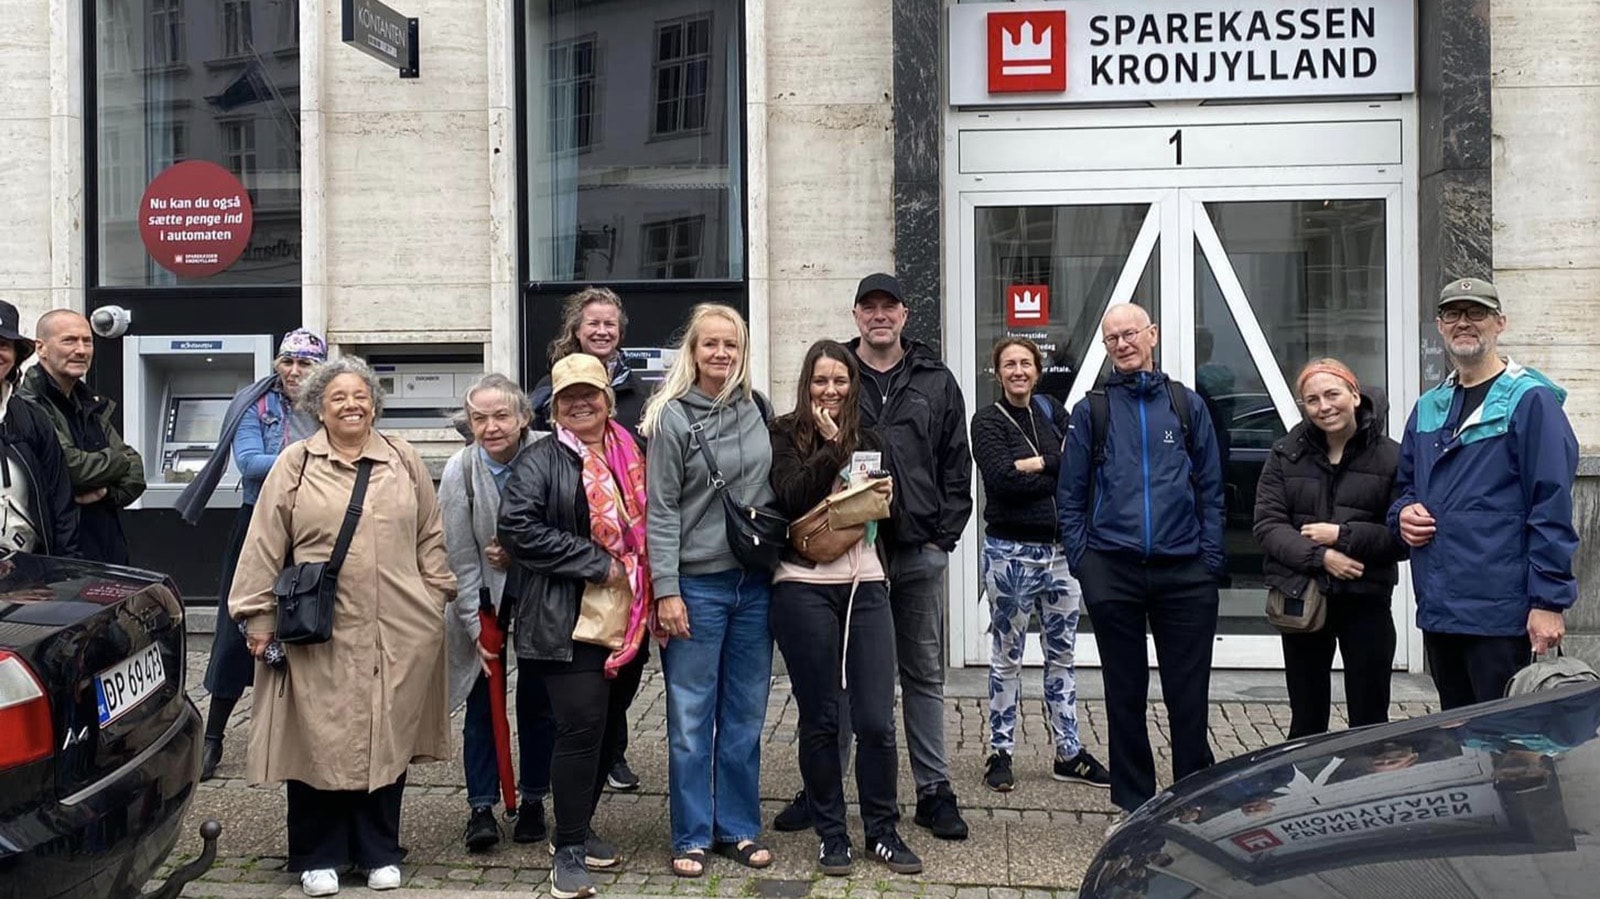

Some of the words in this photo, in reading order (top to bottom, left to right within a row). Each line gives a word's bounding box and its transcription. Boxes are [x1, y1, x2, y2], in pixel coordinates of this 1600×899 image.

[1089, 7, 1375, 46] SPAREKASSEN
[1091, 47, 1377, 86] KRONJYLLAND
[1169, 129, 1182, 165] 1
[150, 198, 167, 209] Nu
[170, 197, 191, 209] kan
[194, 197, 209, 208] du
[213, 195, 241, 210] også
[148, 214, 183, 226] sætte
[185, 215, 221, 227] penge
[224, 212, 243, 224] ind
[167, 230, 231, 241] automaten
[103, 672, 125, 711] DP
[128, 661, 144, 696] 69
[145, 647, 162, 684] 473
[62, 726, 88, 750] A4
